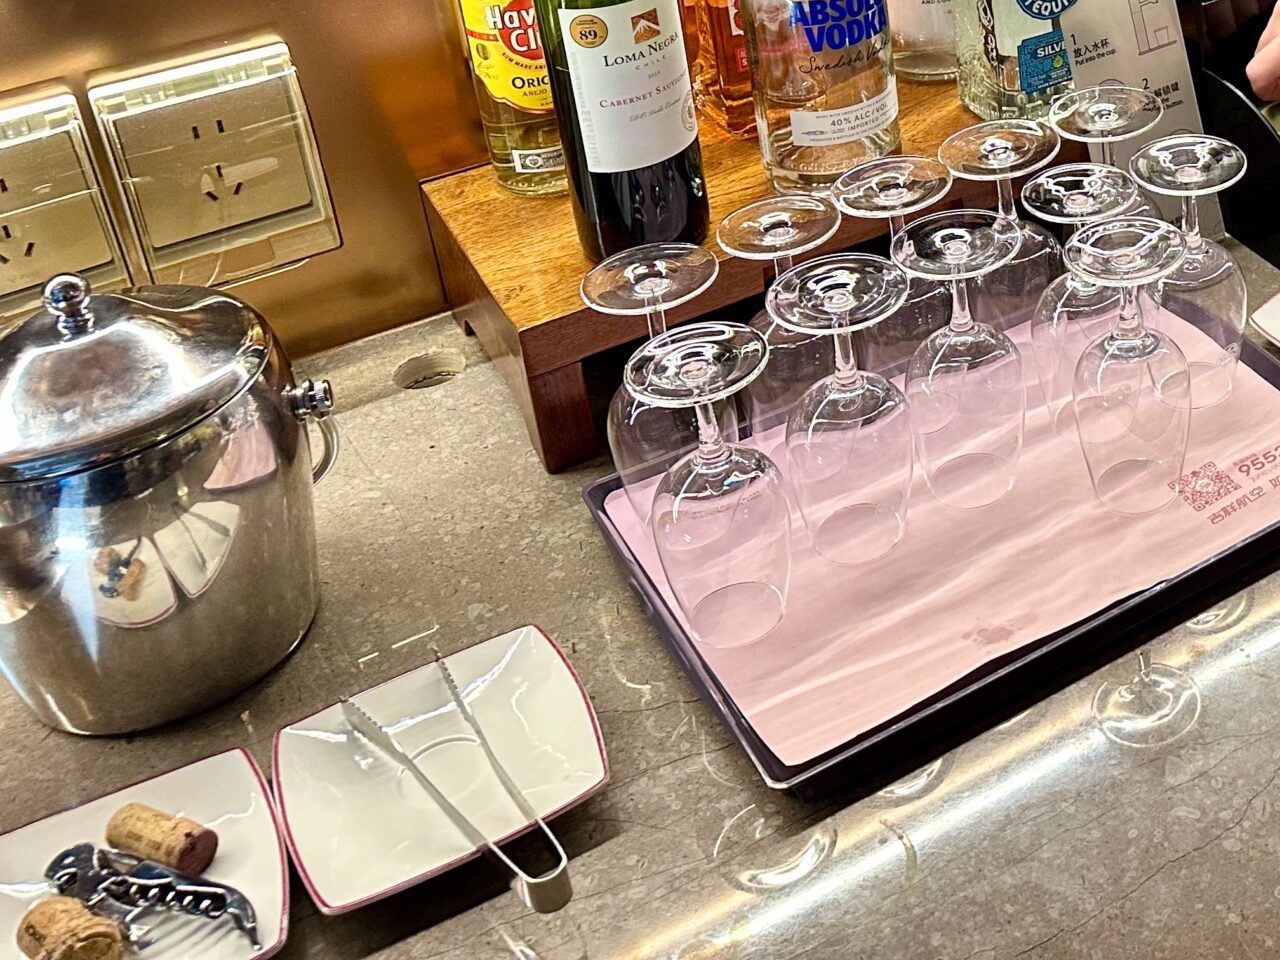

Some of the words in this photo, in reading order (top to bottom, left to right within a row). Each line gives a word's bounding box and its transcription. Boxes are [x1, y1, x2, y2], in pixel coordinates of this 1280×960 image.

[580, 30, 598, 40] 89
[804, 4, 887, 53] VODKA
[1070, 33, 1076, 45] 1
[603, 50, 645, 67] LOMA
[648, 32, 679, 56] NEGRA
[1073, 38, 1110, 58] 放入水杯
[635, 54, 667, 71] CHILE
[799, 49, 862, 73] Swedish
[1075, 58, 1085, 66] Put
[1142, 78, 1150, 90] 2
[600, 91, 653, 108] CABERNET
[831, 117, 851, 126] 40%
[848, 116, 879, 131] IMPORTED
